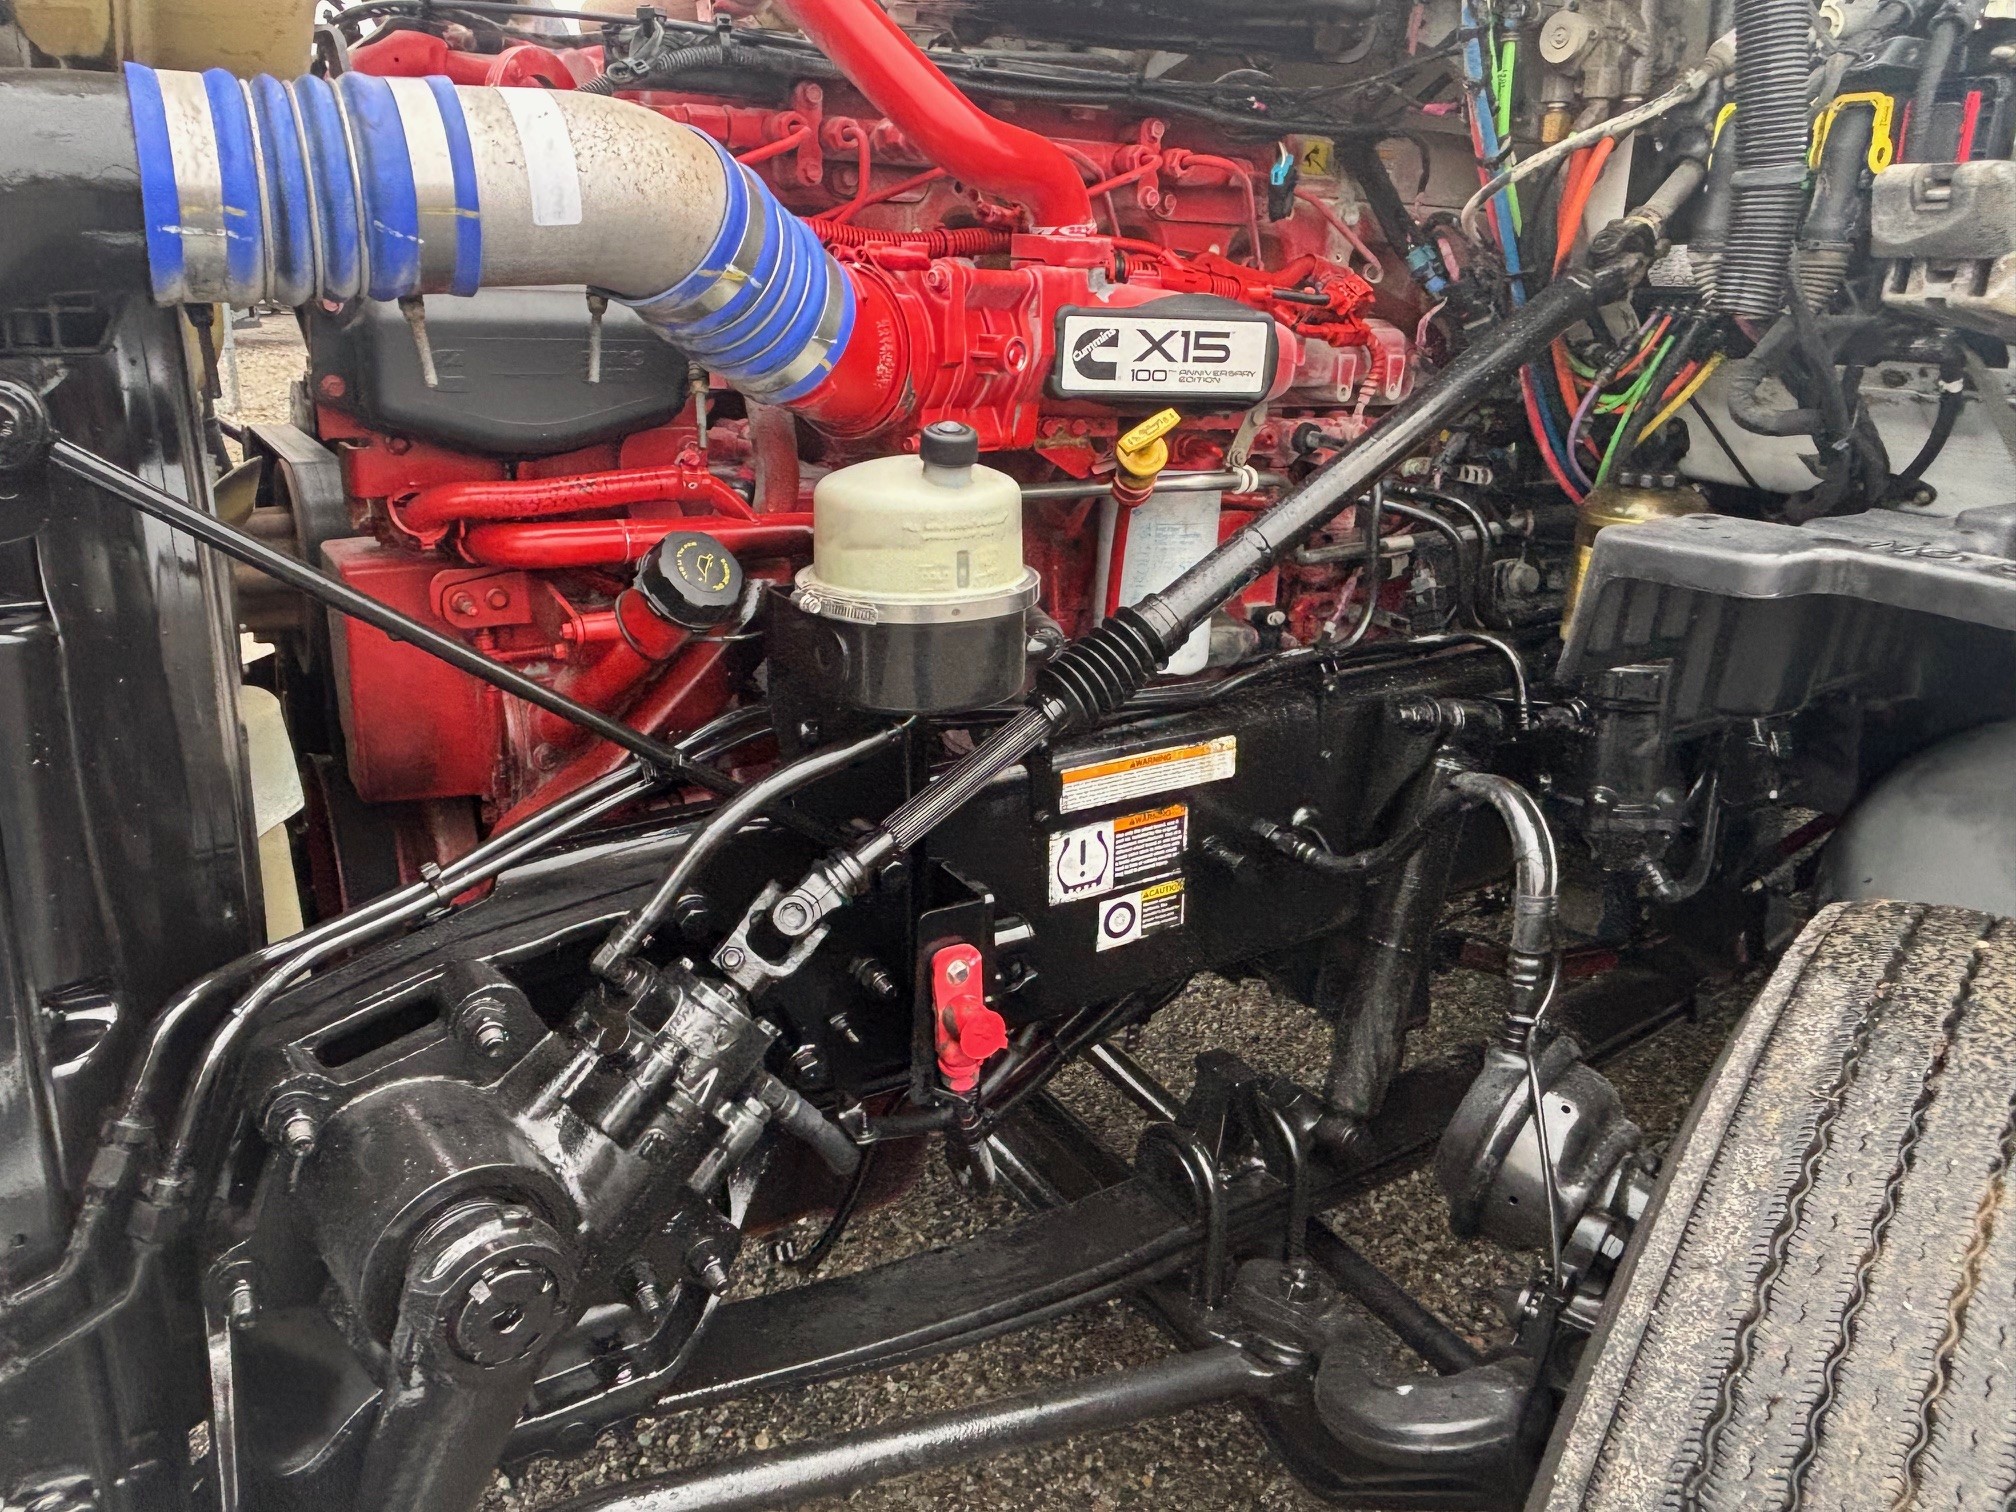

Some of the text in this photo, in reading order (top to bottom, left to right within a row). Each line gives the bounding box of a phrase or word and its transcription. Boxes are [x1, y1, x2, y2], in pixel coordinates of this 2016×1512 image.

[1072, 329, 1116, 362] Cummins
[1133, 329, 1231, 363] X15
[1179, 370, 1256, 378] ANNIVERSARY
[1136, 753, 1172, 767] WARNING
[1134, 808, 1172, 825] WARNG
